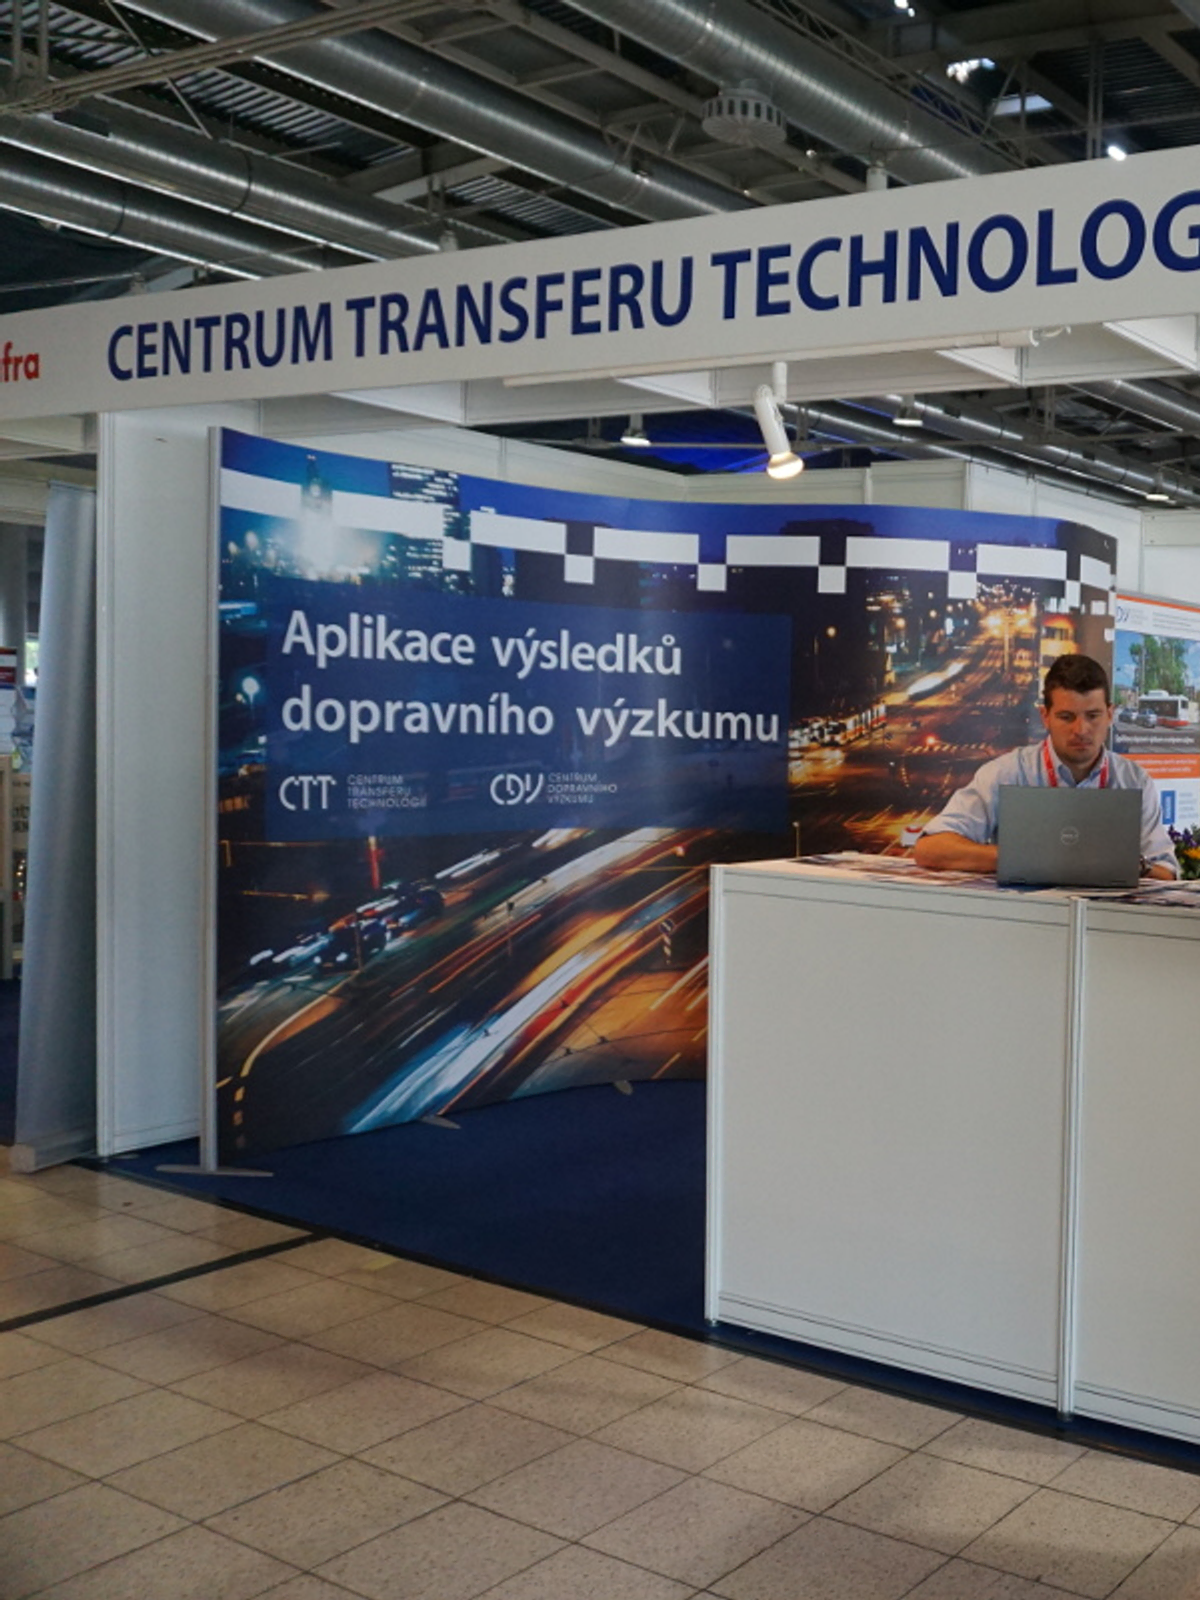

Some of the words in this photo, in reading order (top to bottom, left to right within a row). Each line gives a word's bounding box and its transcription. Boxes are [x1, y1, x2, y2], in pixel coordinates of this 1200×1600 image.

[107, 302, 334, 382] CENTRUM
[345, 255, 694, 358] TRANSFERU
[0, 340, 40, 383] fra
[281, 609, 476, 669] Aplikace
[490, 627, 683, 680] výsledků
[281, 684, 555, 744] dopravního
[575, 697, 781, 748] výzkumu
[346, 773, 404, 785] CENTRUM
[346, 785, 412, 797] TRANSFERU
[547, 771, 599, 783] CENTRUM
